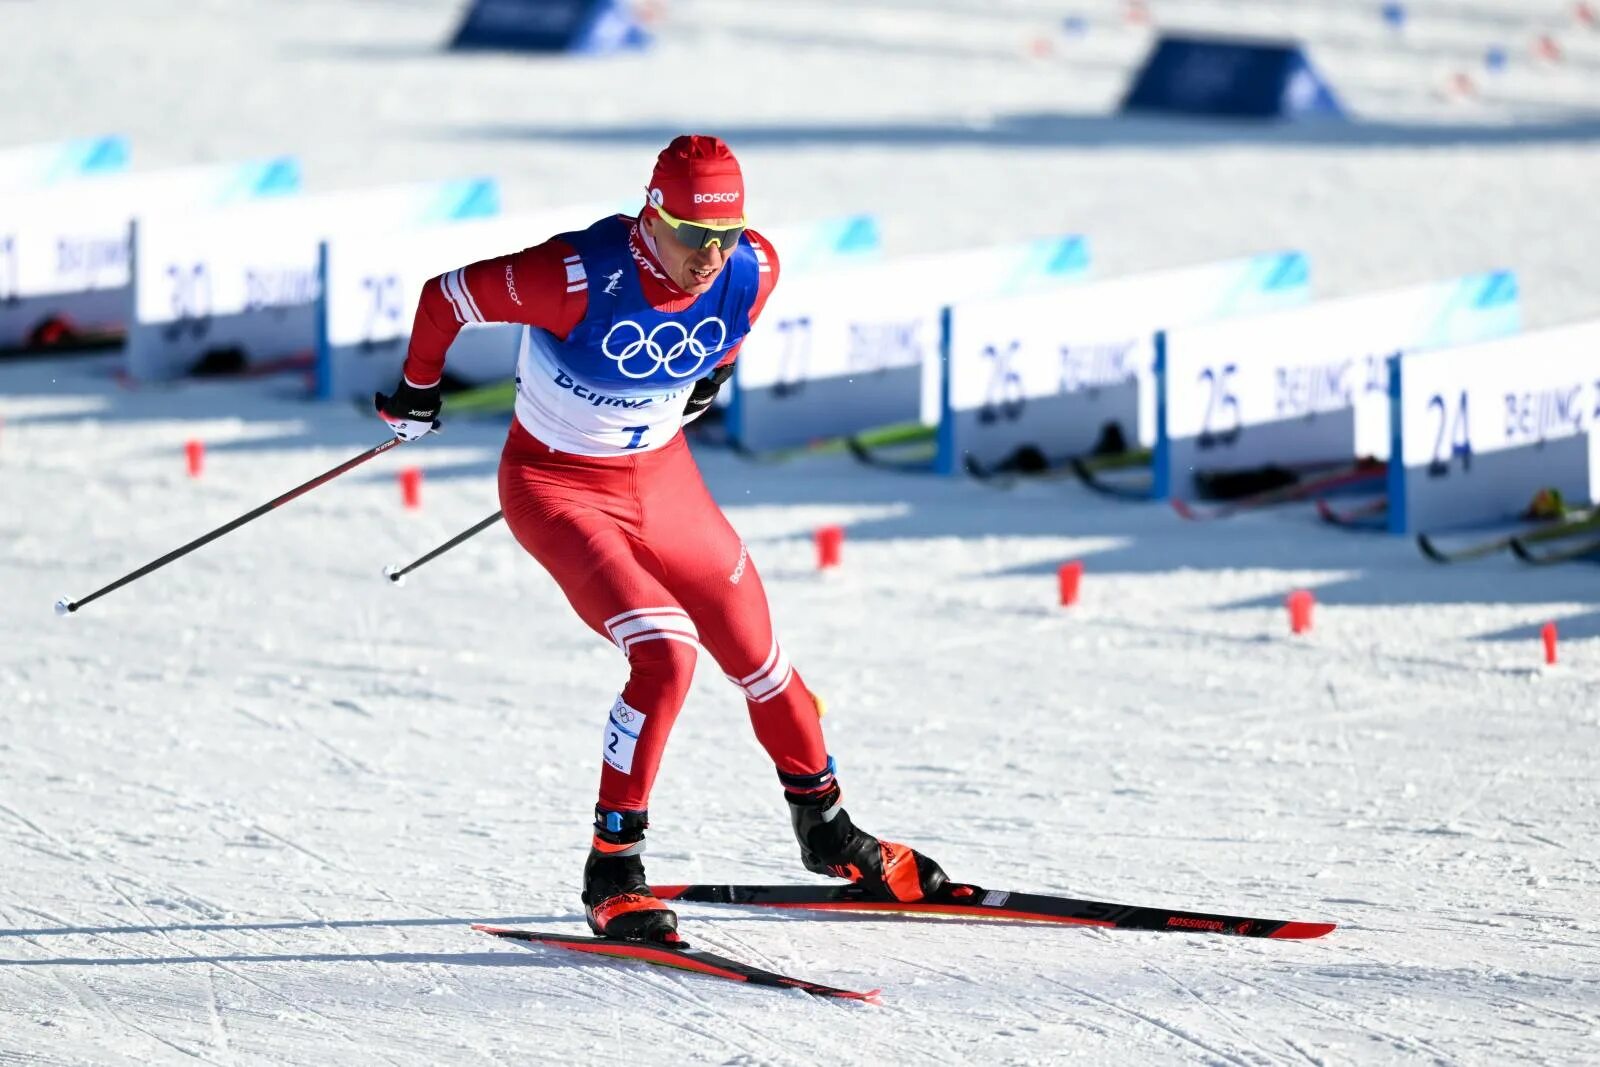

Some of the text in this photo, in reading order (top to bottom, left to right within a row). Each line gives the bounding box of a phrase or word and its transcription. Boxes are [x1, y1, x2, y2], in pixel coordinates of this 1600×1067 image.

[694, 192, 738, 204] BOSCO
[505, 264, 518, 302] BOSCO
[1198, 363, 1242, 449] 25
[1428, 389, 1474, 477] 24
[1504, 384, 1582, 450] BEIJING
[607, 731, 619, 755] 2
[1167, 915, 1225, 931] ROSSIGNOL
